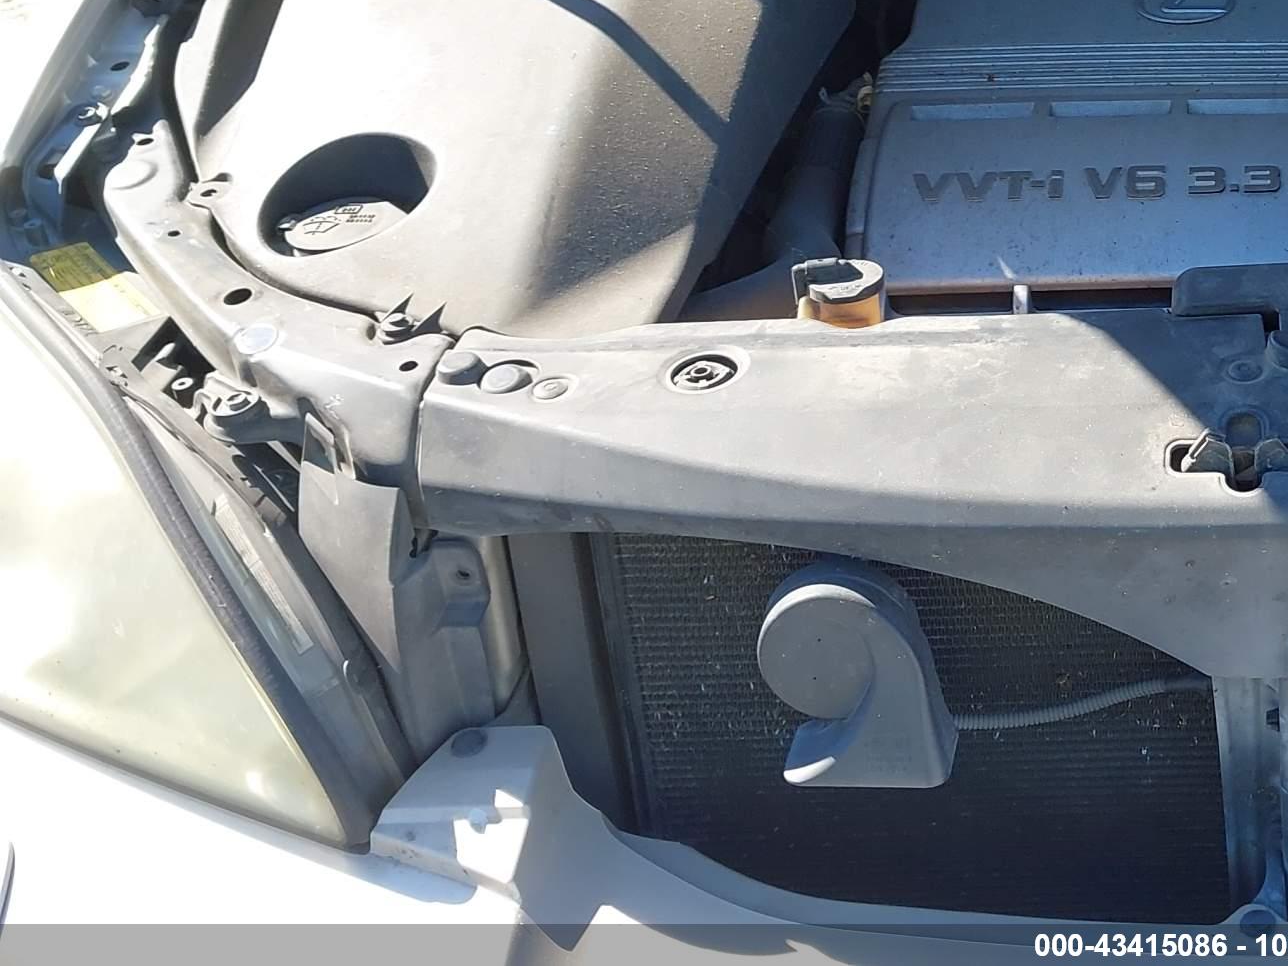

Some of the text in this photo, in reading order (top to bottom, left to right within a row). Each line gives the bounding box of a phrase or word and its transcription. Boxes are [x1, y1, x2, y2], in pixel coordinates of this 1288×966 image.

[912, 165, 1281, 202] VVT-i V6 3.3
